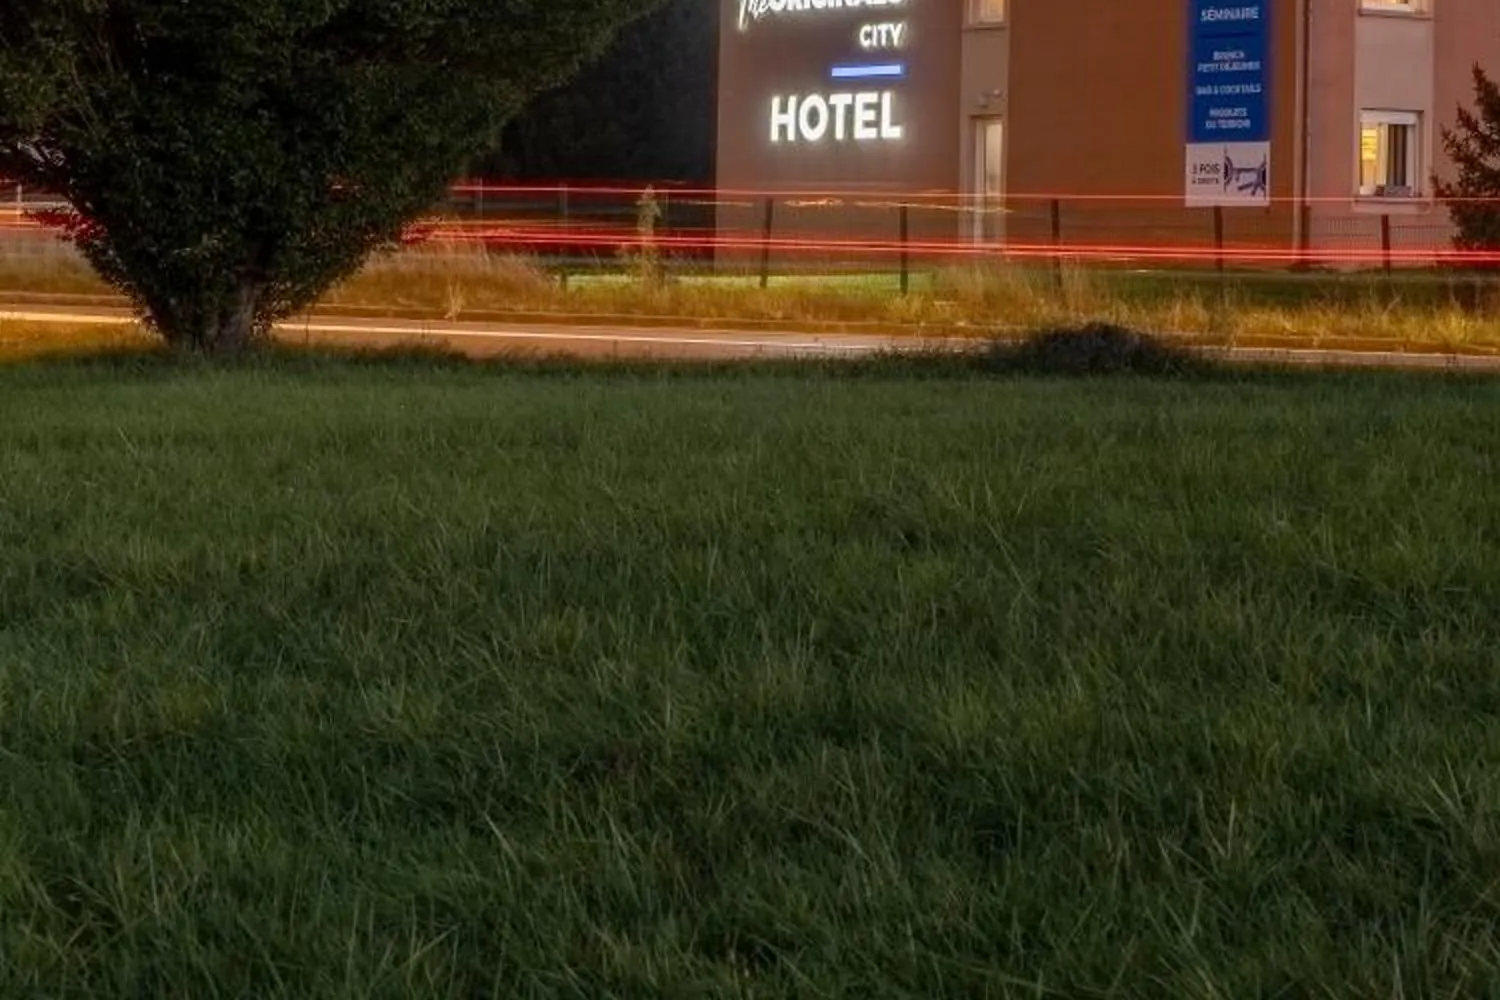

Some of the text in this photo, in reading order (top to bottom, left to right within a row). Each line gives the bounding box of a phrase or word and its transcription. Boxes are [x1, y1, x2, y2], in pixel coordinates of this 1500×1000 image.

[1201, 6, 1259, 21] SÉMINAIRE
[859, 23, 903, 47] CITY
[770, 91, 902, 142] HOTEL
